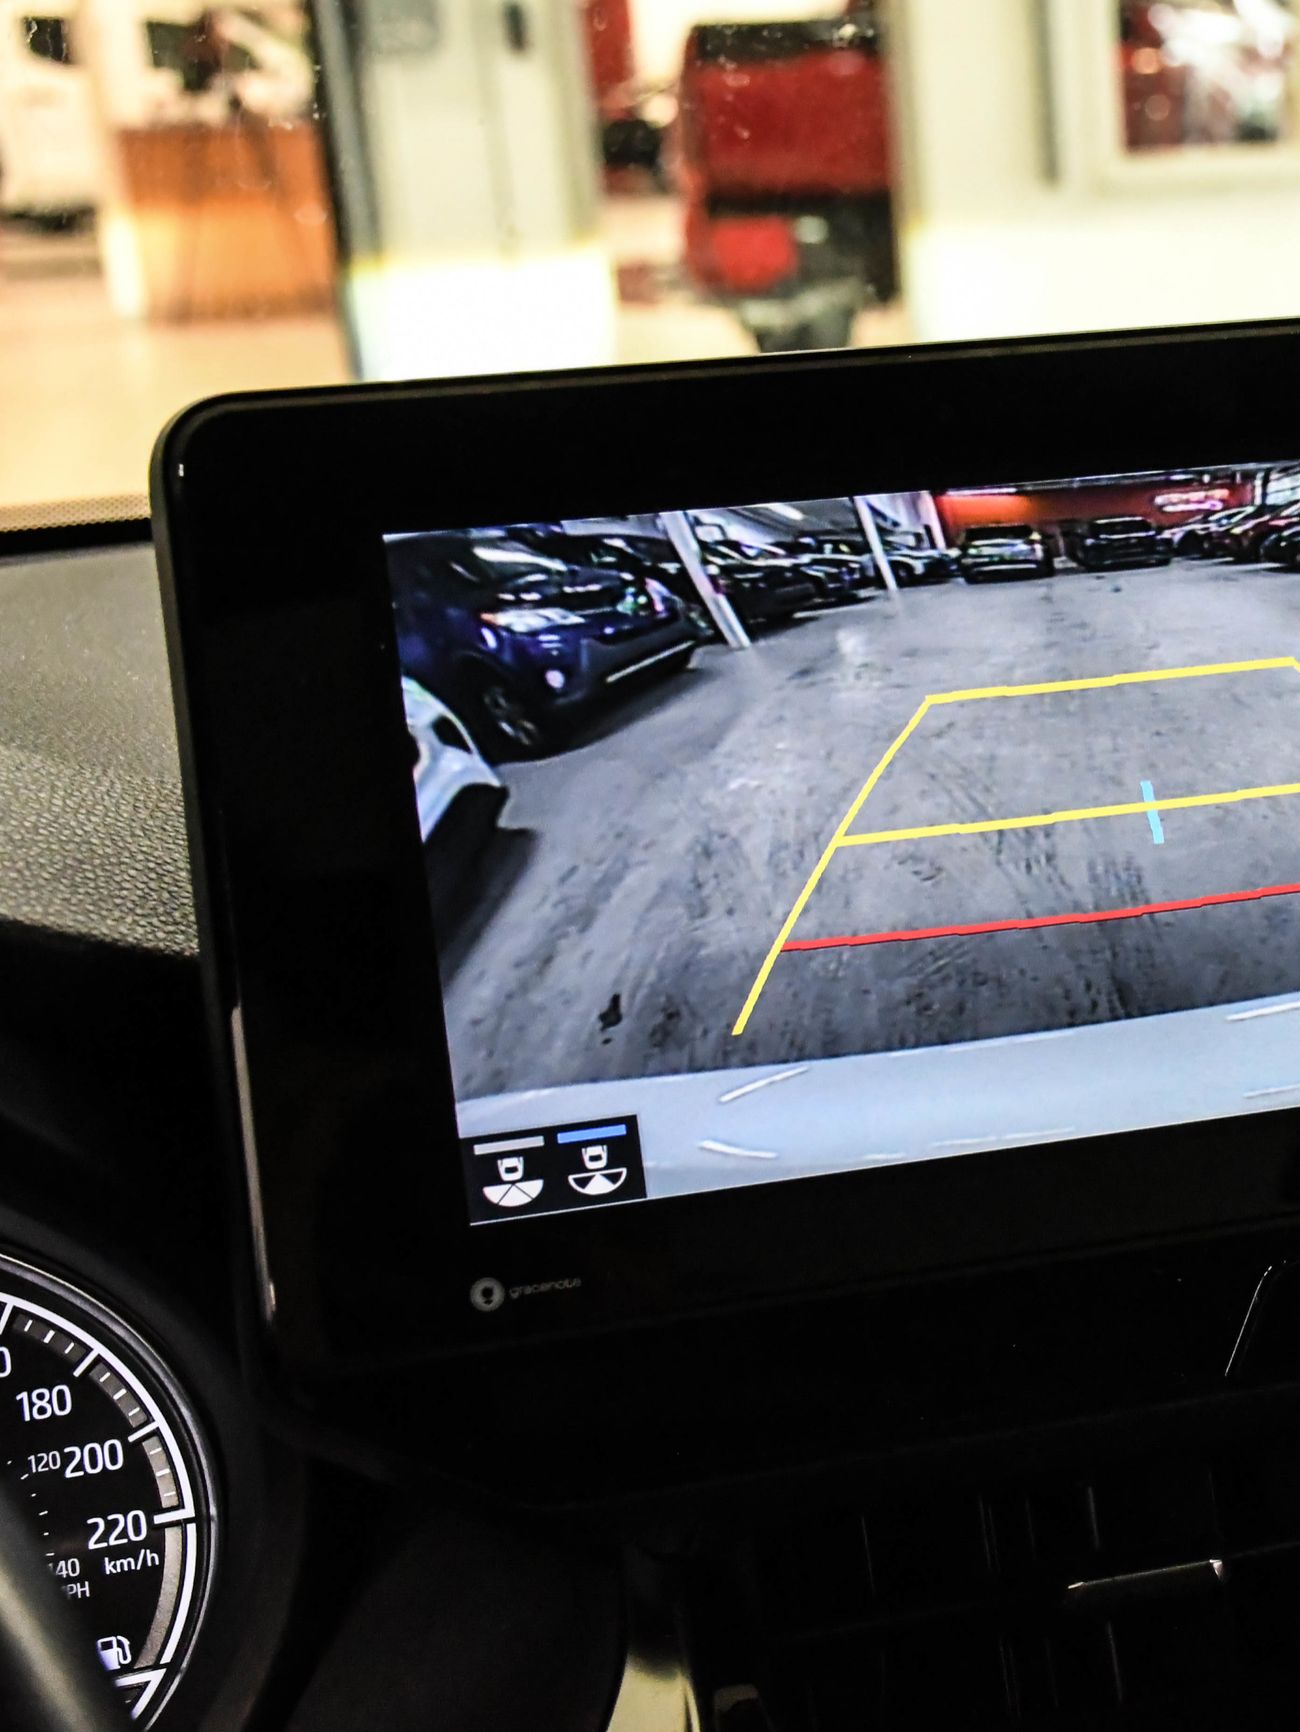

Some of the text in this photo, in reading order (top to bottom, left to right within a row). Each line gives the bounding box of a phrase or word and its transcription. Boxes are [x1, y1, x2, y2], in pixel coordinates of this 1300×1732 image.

[15, 1384, 72, 1421] 180
[27, 1450, 61, 1474] 120
[63, 1438, 124, 1478] 200
[86, 1509, 148, 1550] 220
[104, 1549, 160, 1576] km/h
[61, 1580, 91, 1600] PH
